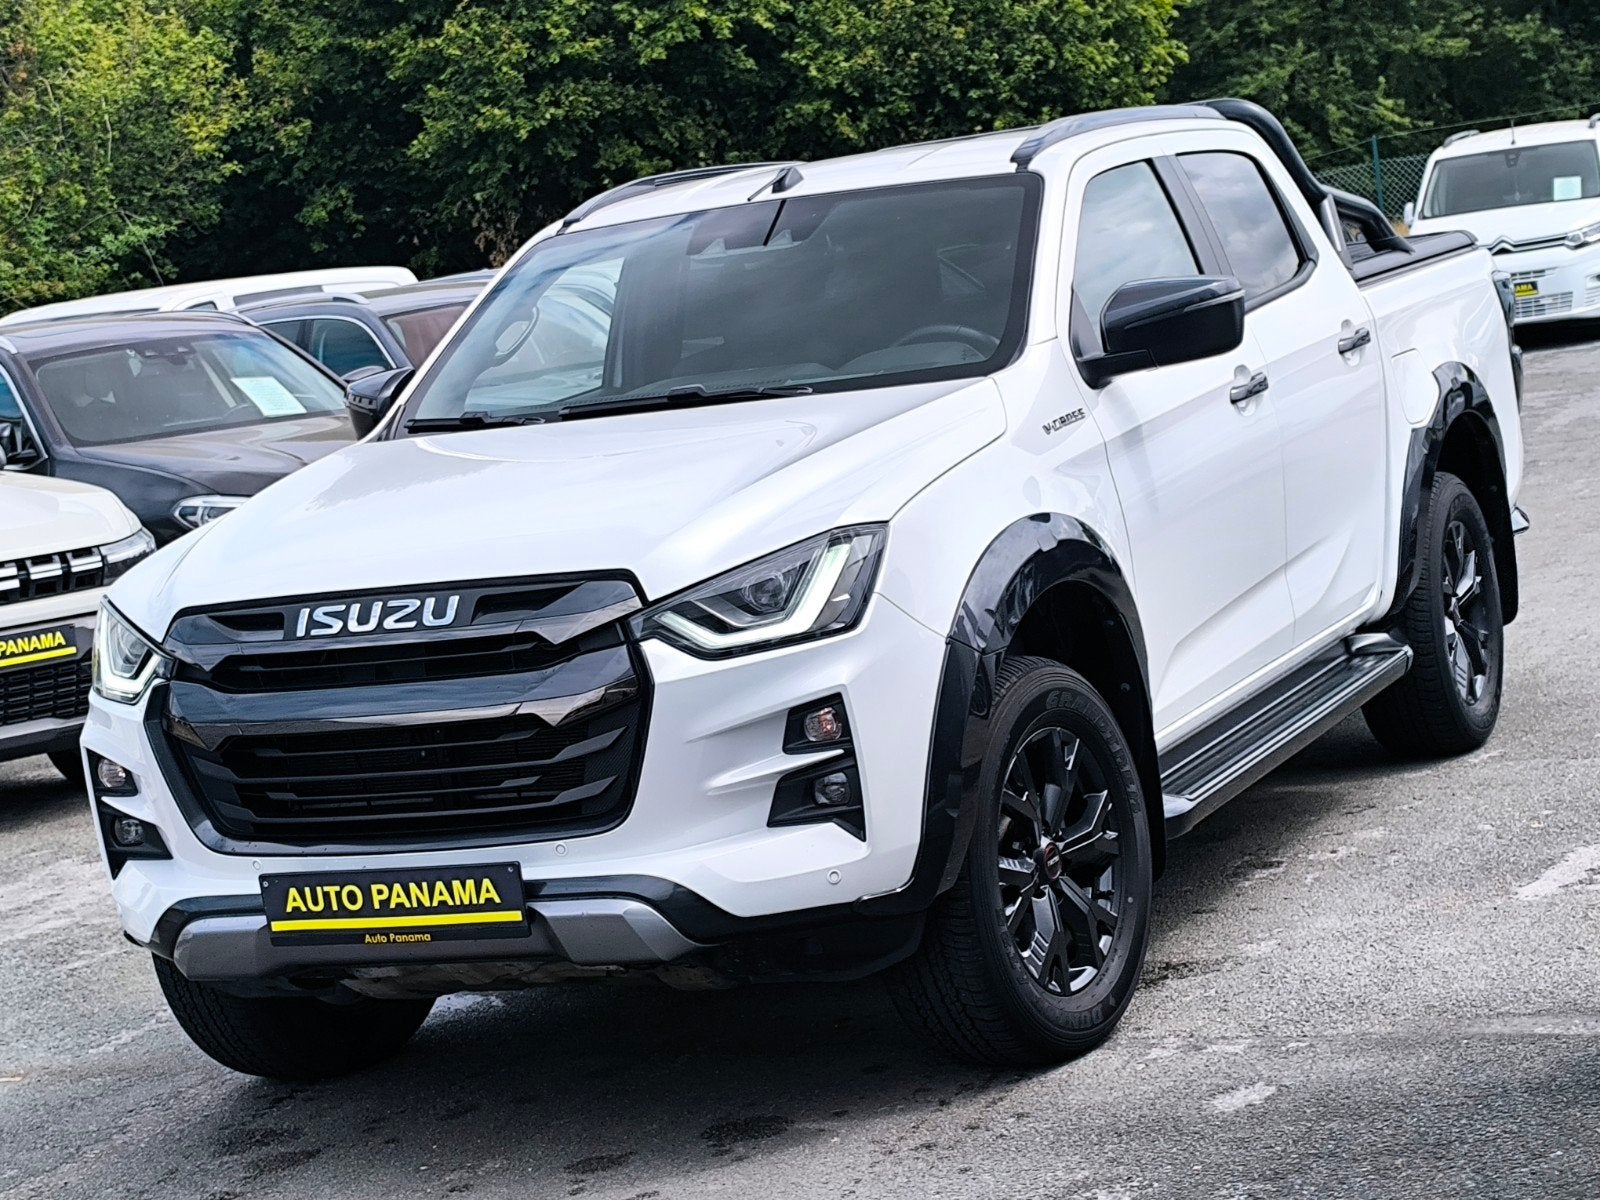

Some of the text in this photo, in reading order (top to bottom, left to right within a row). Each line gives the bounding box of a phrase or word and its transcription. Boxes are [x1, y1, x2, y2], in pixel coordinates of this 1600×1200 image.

[1515, 283, 1533, 292] AMA
[296, 595, 460, 637] ISUZU
[0, 631, 66, 656] PANAMA
[286, 878, 501, 912] AUTO PANAMA
[364, 932, 431, 944] Auto Panama
